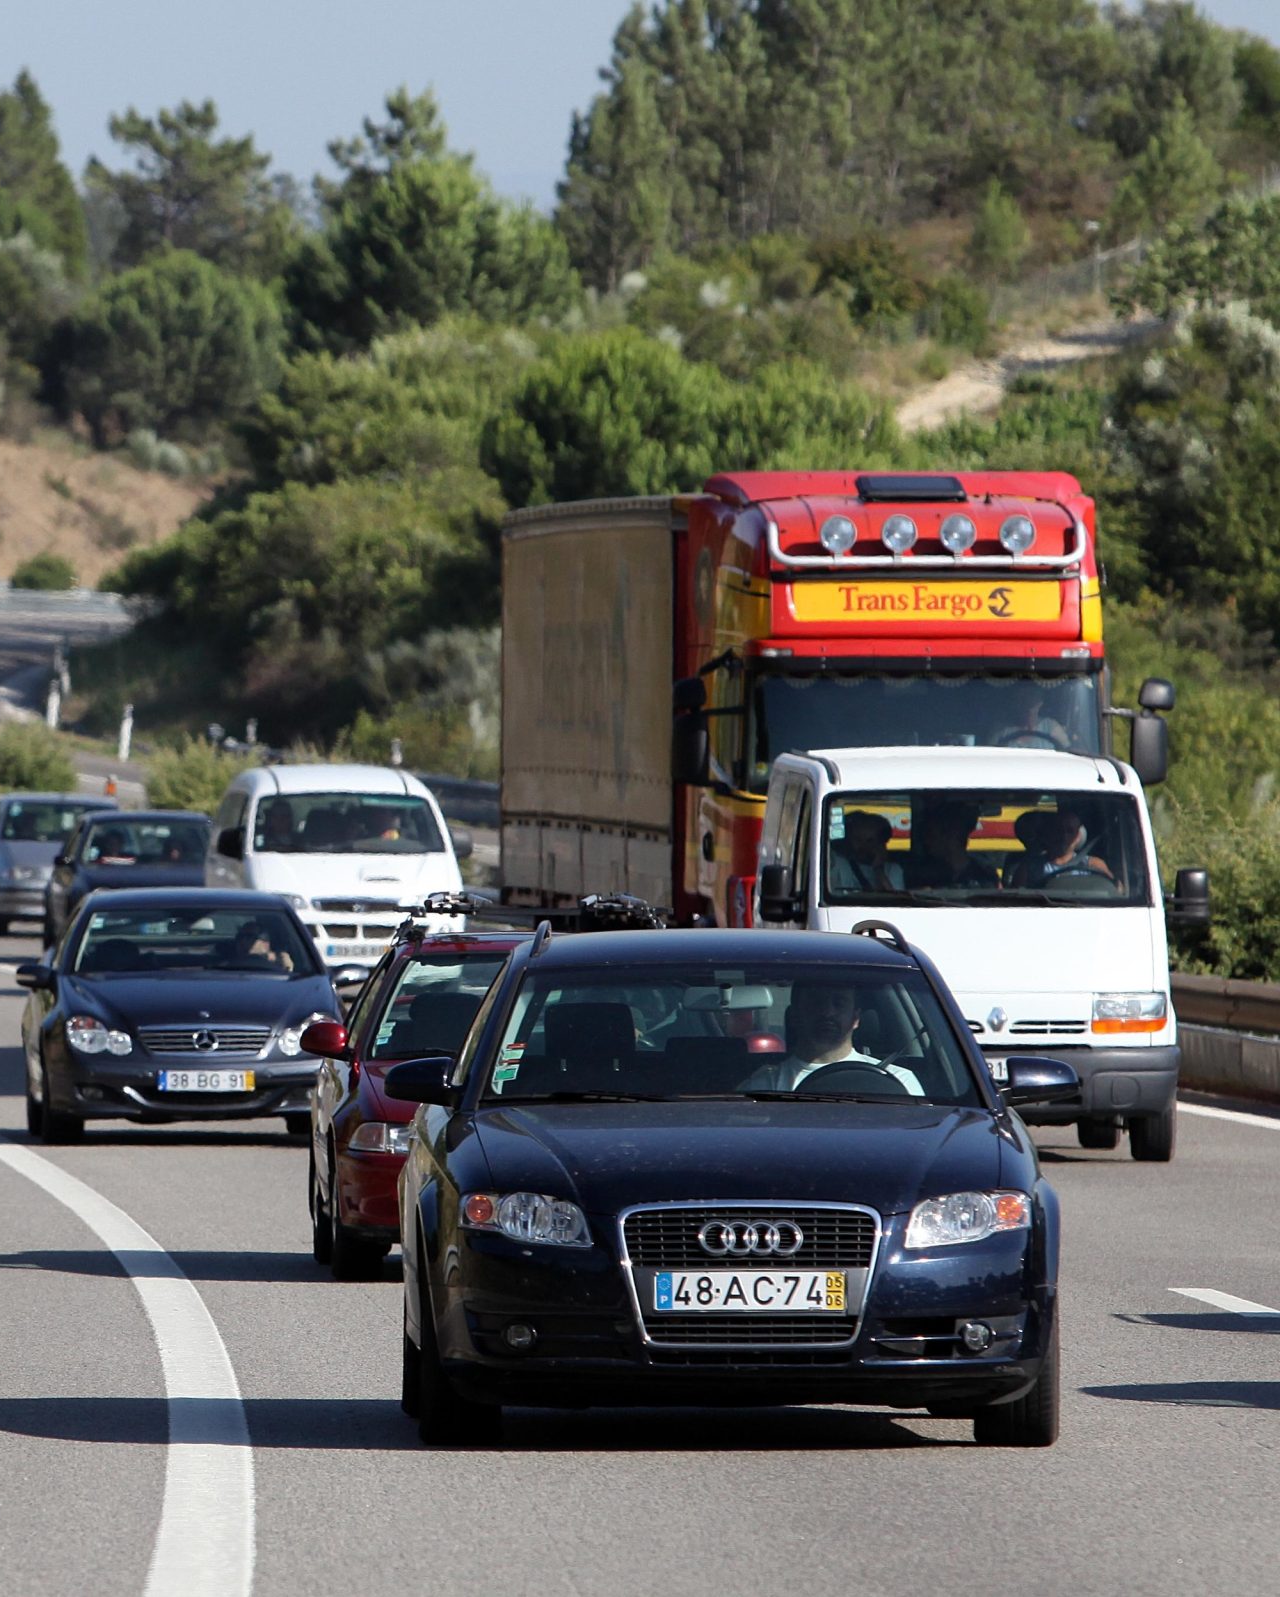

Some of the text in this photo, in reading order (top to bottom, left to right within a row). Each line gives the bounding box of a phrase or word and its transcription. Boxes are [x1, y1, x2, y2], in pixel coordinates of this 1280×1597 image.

[838, 585, 983, 618] Trans Fargo
[826, 1276, 843, 1288] 05
[660, 1295, 669, 1304] P
[826, 1294, 843, 1306] 06
